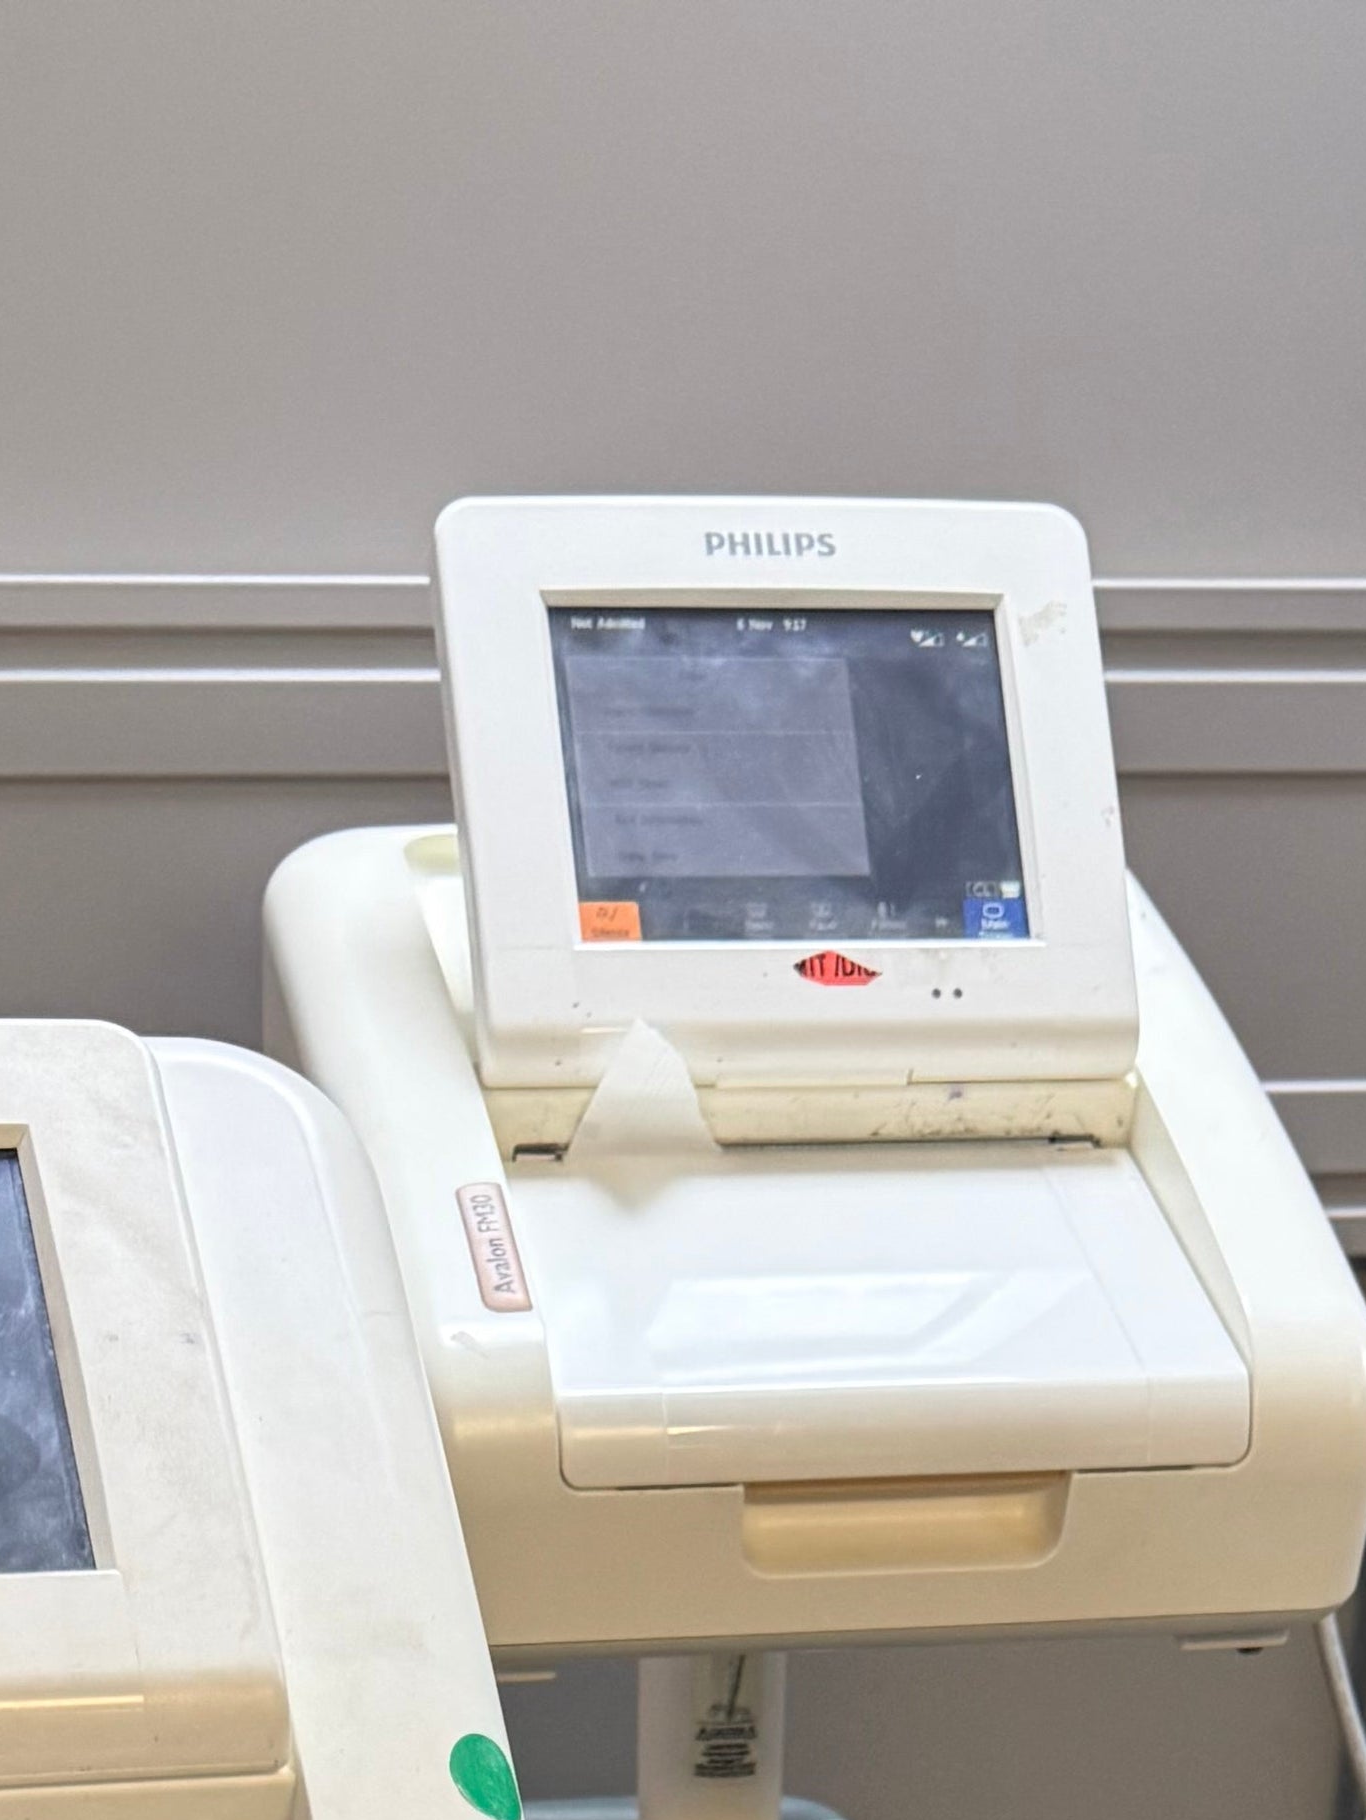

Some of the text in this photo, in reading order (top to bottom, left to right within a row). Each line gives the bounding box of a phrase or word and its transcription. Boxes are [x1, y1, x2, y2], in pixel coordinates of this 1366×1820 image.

[704, 531, 837, 557] PHILIPS
[469, 1194, 516, 1294] Avalon FM30
